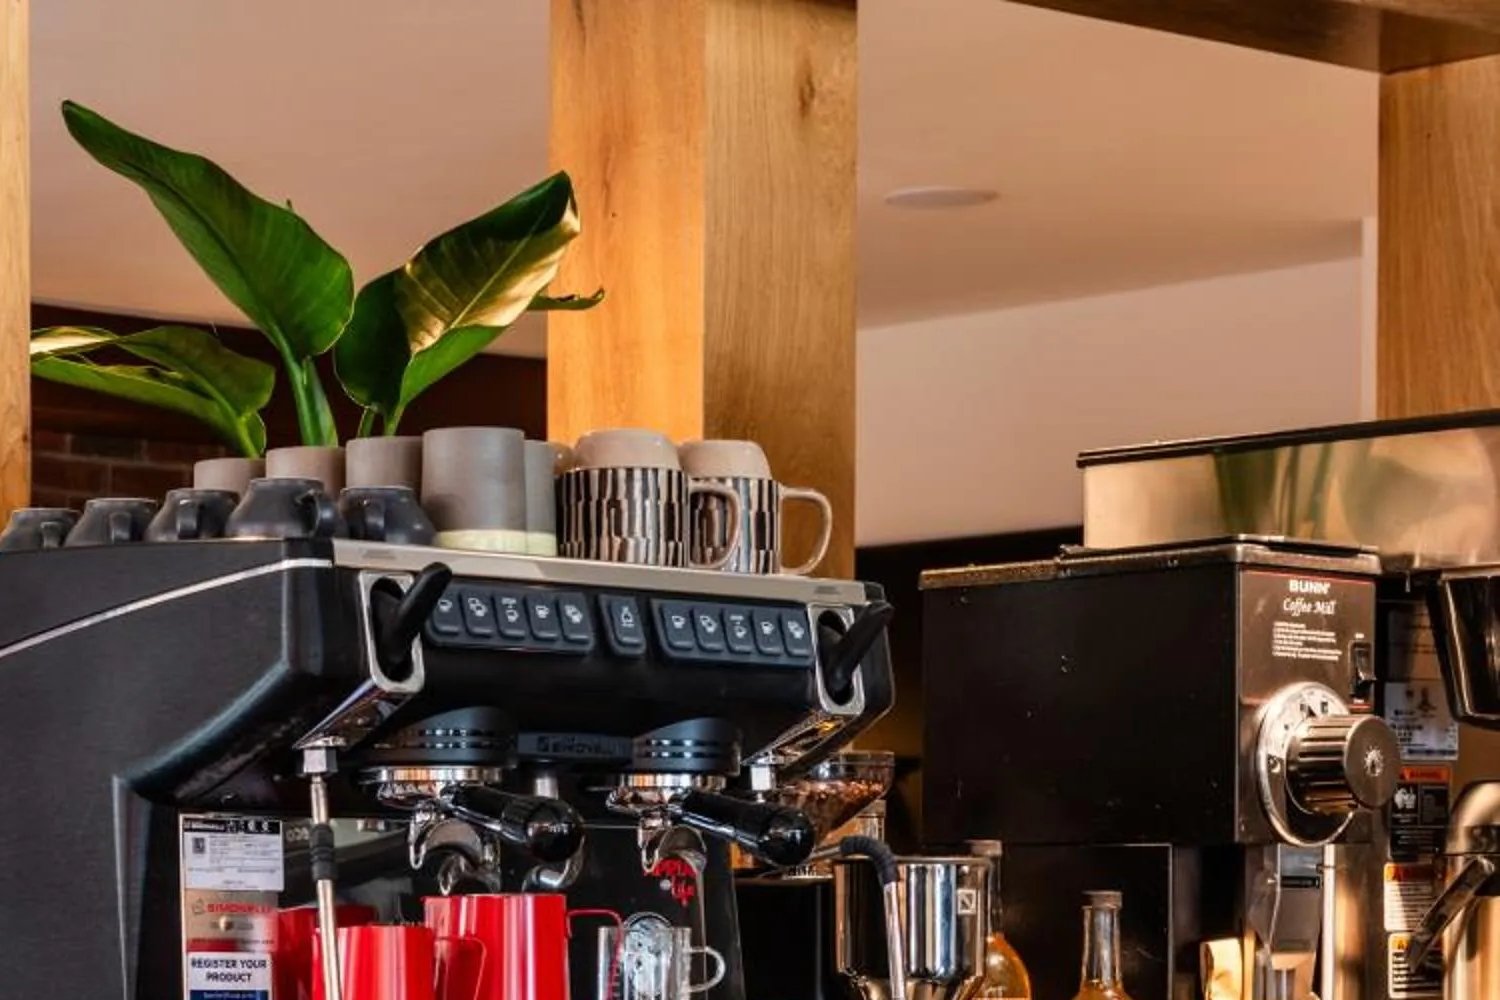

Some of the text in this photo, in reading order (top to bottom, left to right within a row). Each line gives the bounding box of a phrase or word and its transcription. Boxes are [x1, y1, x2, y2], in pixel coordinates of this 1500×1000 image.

[1288, 579, 1329, 594] BUNN
[1283, 598, 1336, 616] Coffee Mill
[191, 958, 268, 969] REGISTER YOUR
[206, 972, 253, 983] PRODUCT
